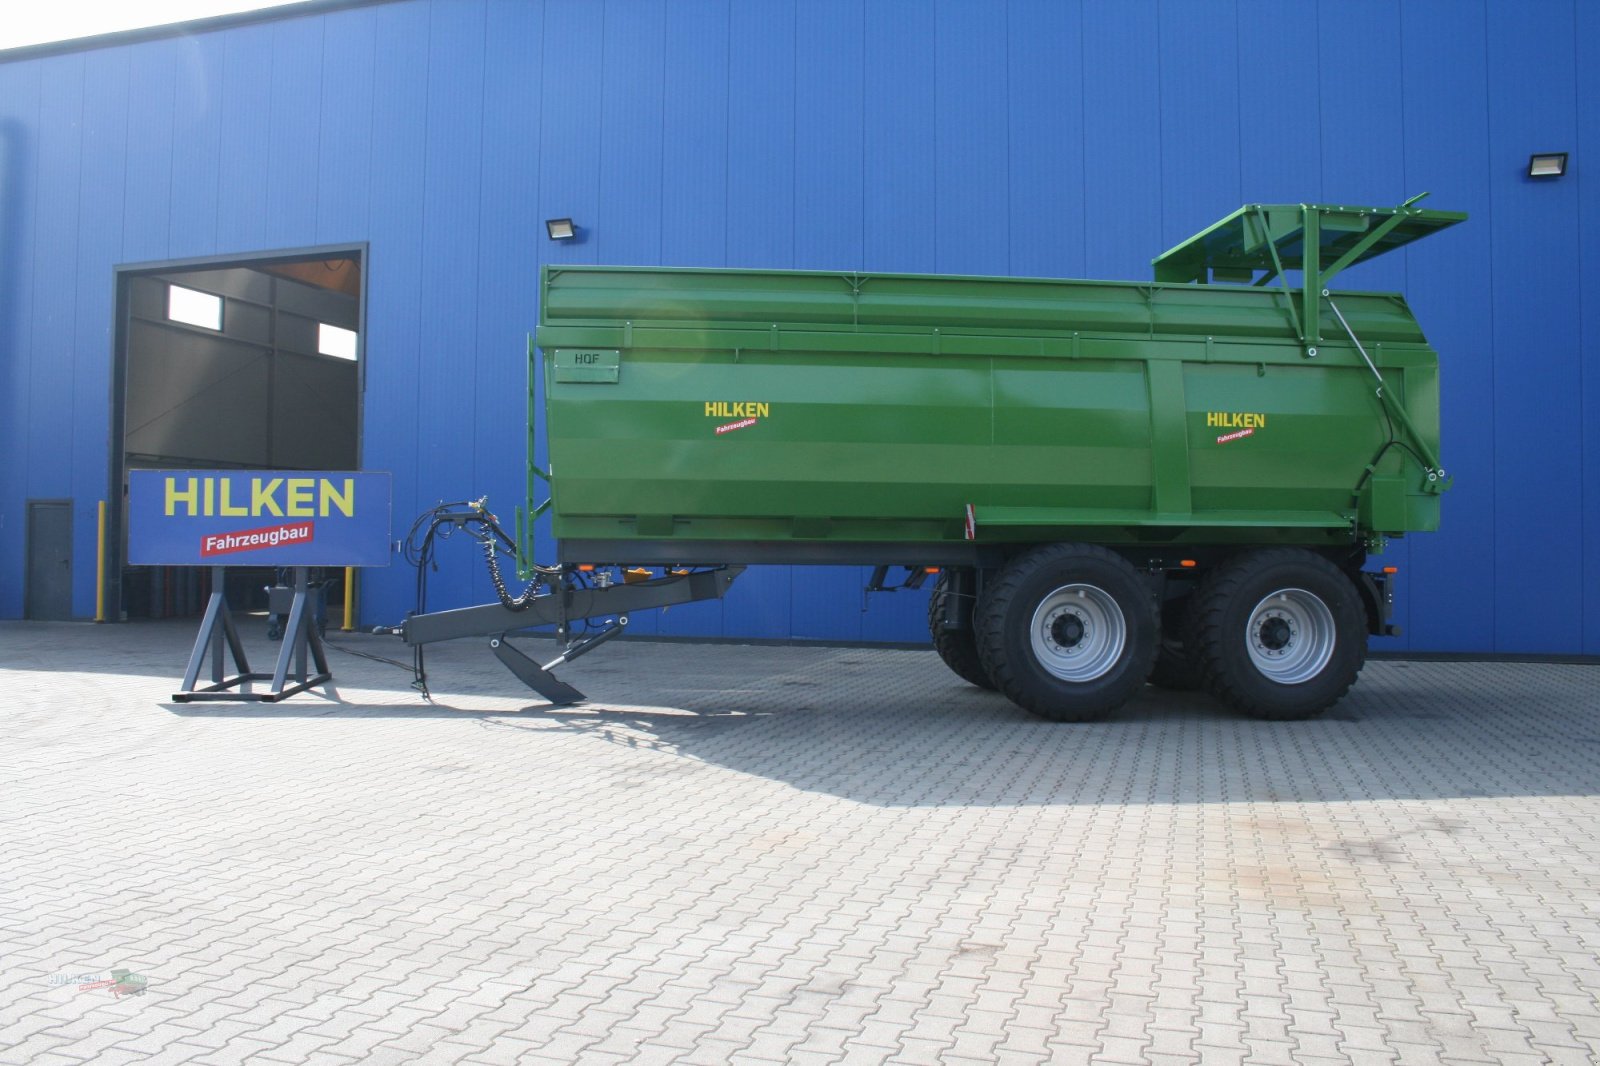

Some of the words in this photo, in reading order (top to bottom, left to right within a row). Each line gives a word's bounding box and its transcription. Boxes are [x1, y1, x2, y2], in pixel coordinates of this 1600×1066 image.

[705, 402, 769, 417] HILKEN
[716, 418, 756, 433] Fahrzeugbau
[1207, 412, 1265, 428] HILKEN
[164, 477, 354, 517] HILKEN
[206, 525, 309, 551] Fahrzeugbau
